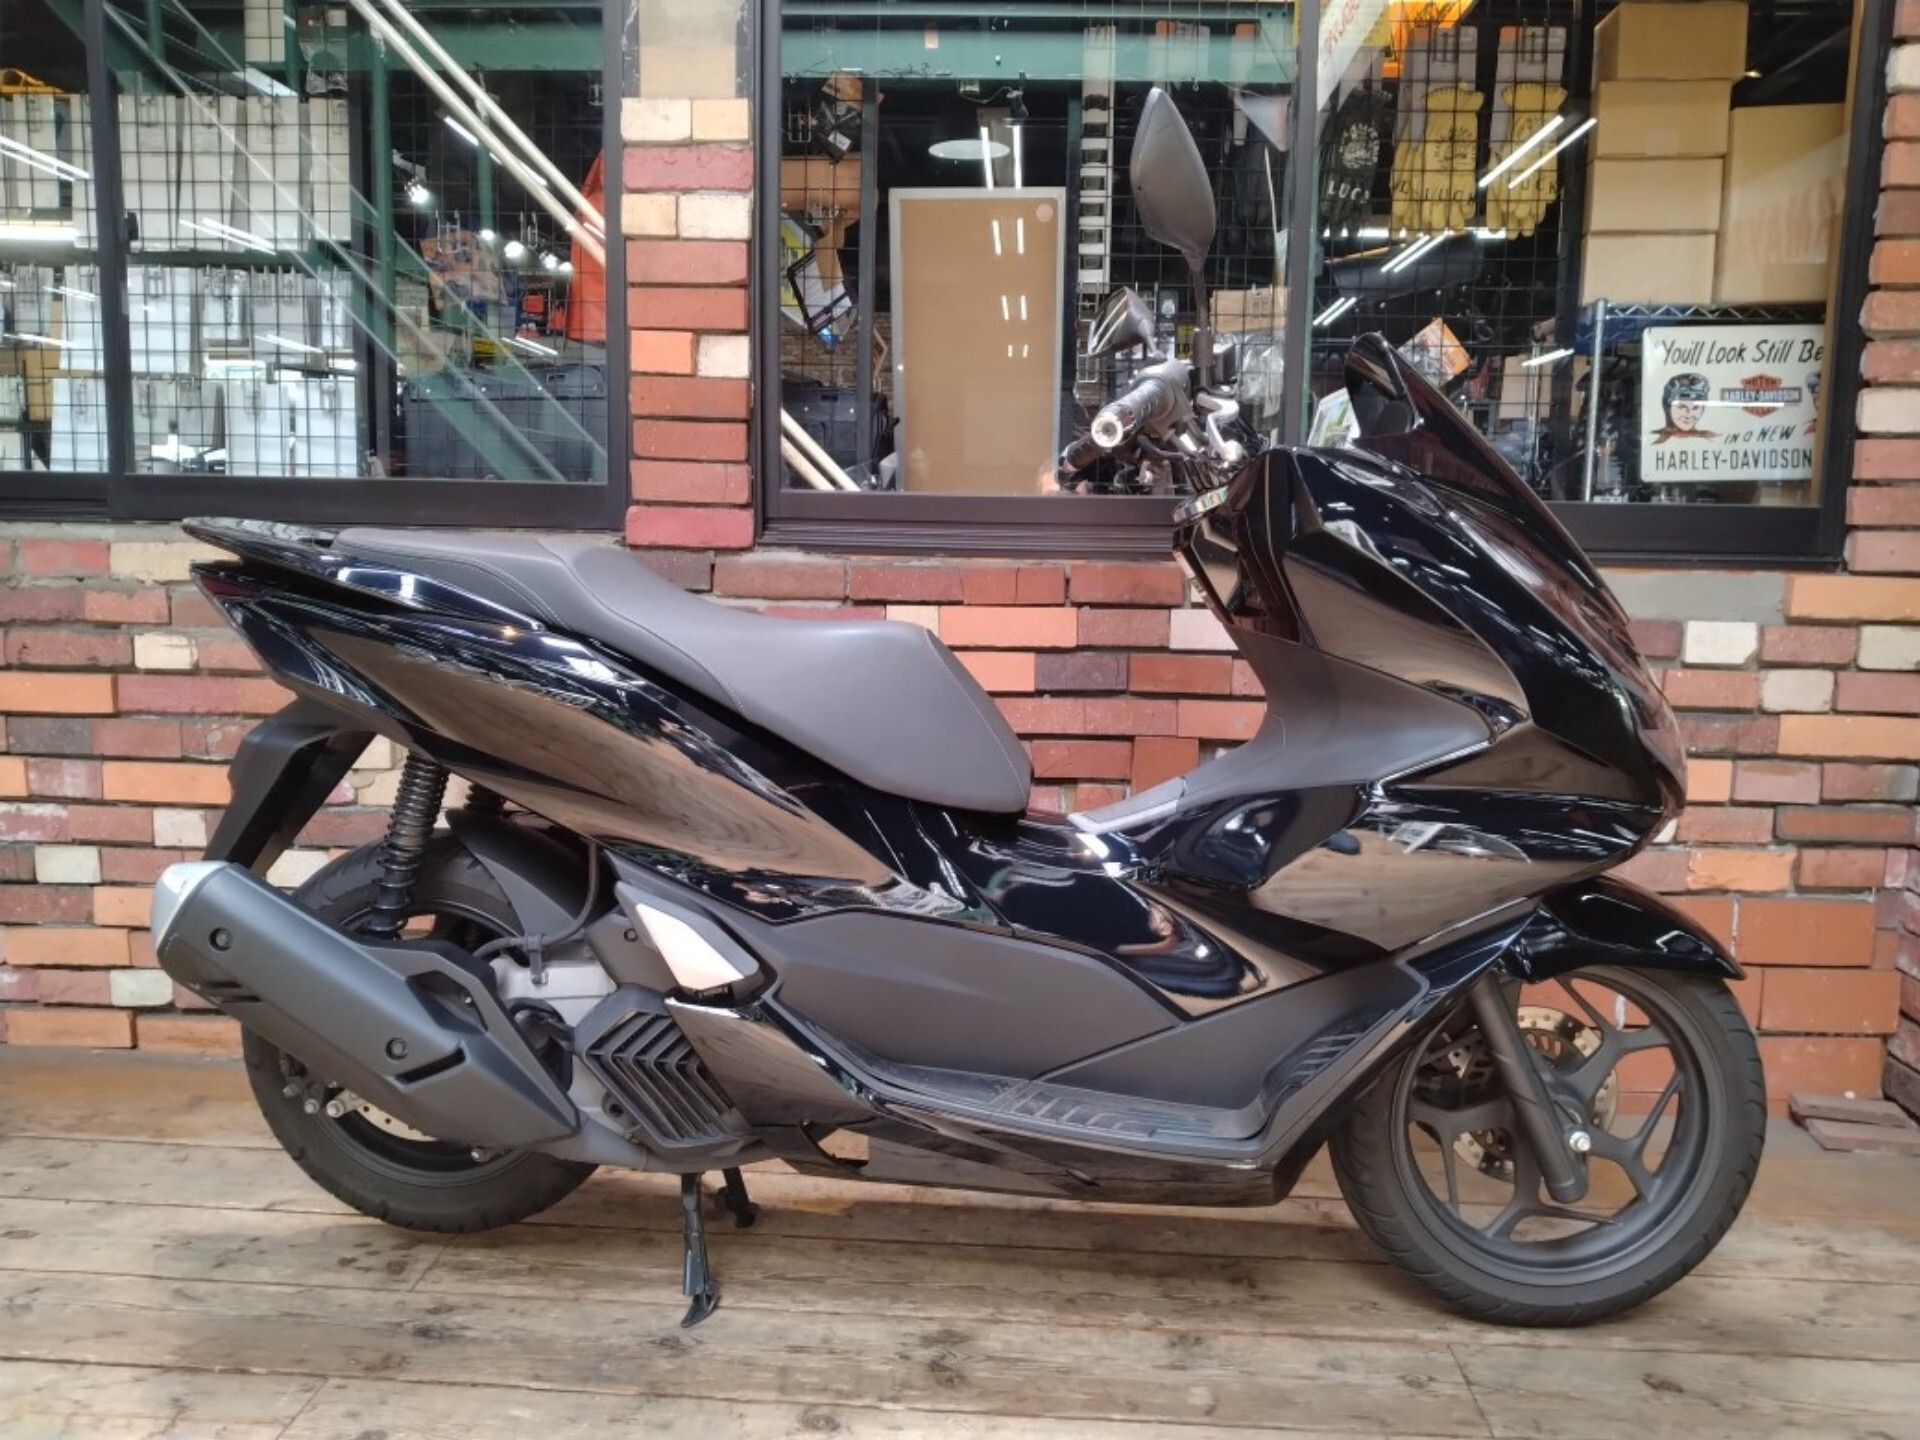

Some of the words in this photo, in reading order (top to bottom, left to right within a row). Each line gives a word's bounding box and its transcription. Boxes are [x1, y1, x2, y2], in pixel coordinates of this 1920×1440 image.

[1706, 340, 1748, 366] Look
[1752, 339, 1795, 365] Still
[1724, 432, 1740, 445] IN
[1756, 425, 1796, 443] NEW
[1656, 449, 1813, 471] HARLEY-DAVIDSON
